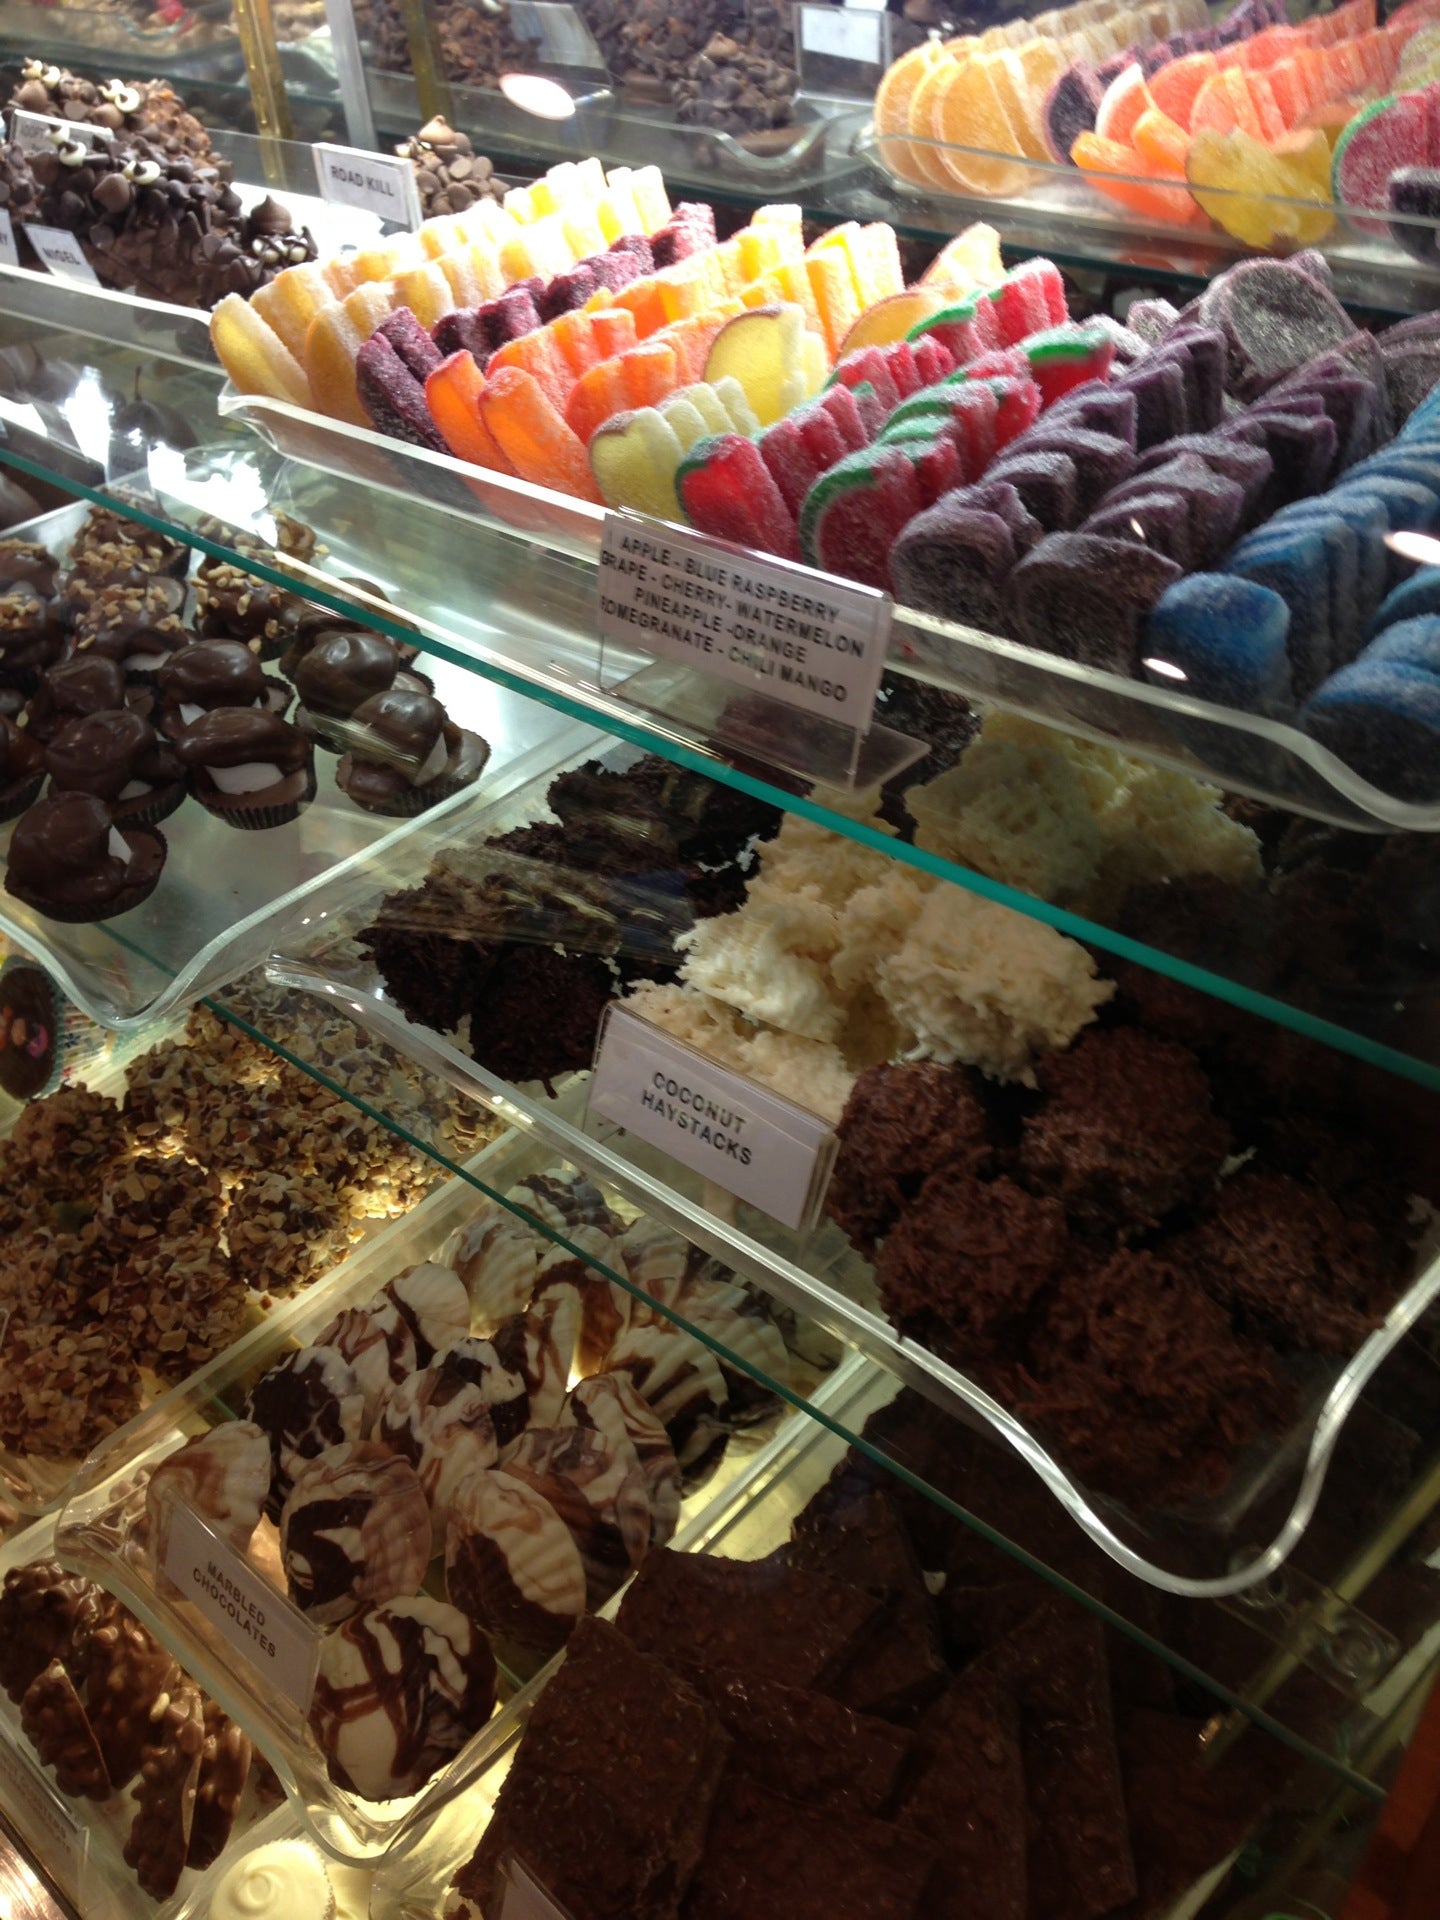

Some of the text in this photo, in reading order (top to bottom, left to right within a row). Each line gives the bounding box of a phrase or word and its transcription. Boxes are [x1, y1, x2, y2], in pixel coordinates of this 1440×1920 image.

[331, 166, 363, 187] ROAD
[601, 550, 647, 581] GRAPE
[736, 600, 865, 659] WATERMELON
[621, 536, 673, 566] APPLE
[684, 558, 727, 587] BLUE
[732, 573, 840, 623] RASPBERRY
[635, 587, 722, 634] PINEAPPLE
[728, 646, 775, 675] CHILI
[779, 665, 848, 703] MANGO
[641, 1090, 753, 1166] HAYSTACKS
[653, 1072, 746, 1134] COCONUT
[193, 1567, 276, 1658] CHOCOLATES
[207, 1561, 265, 1627] MARBLED
